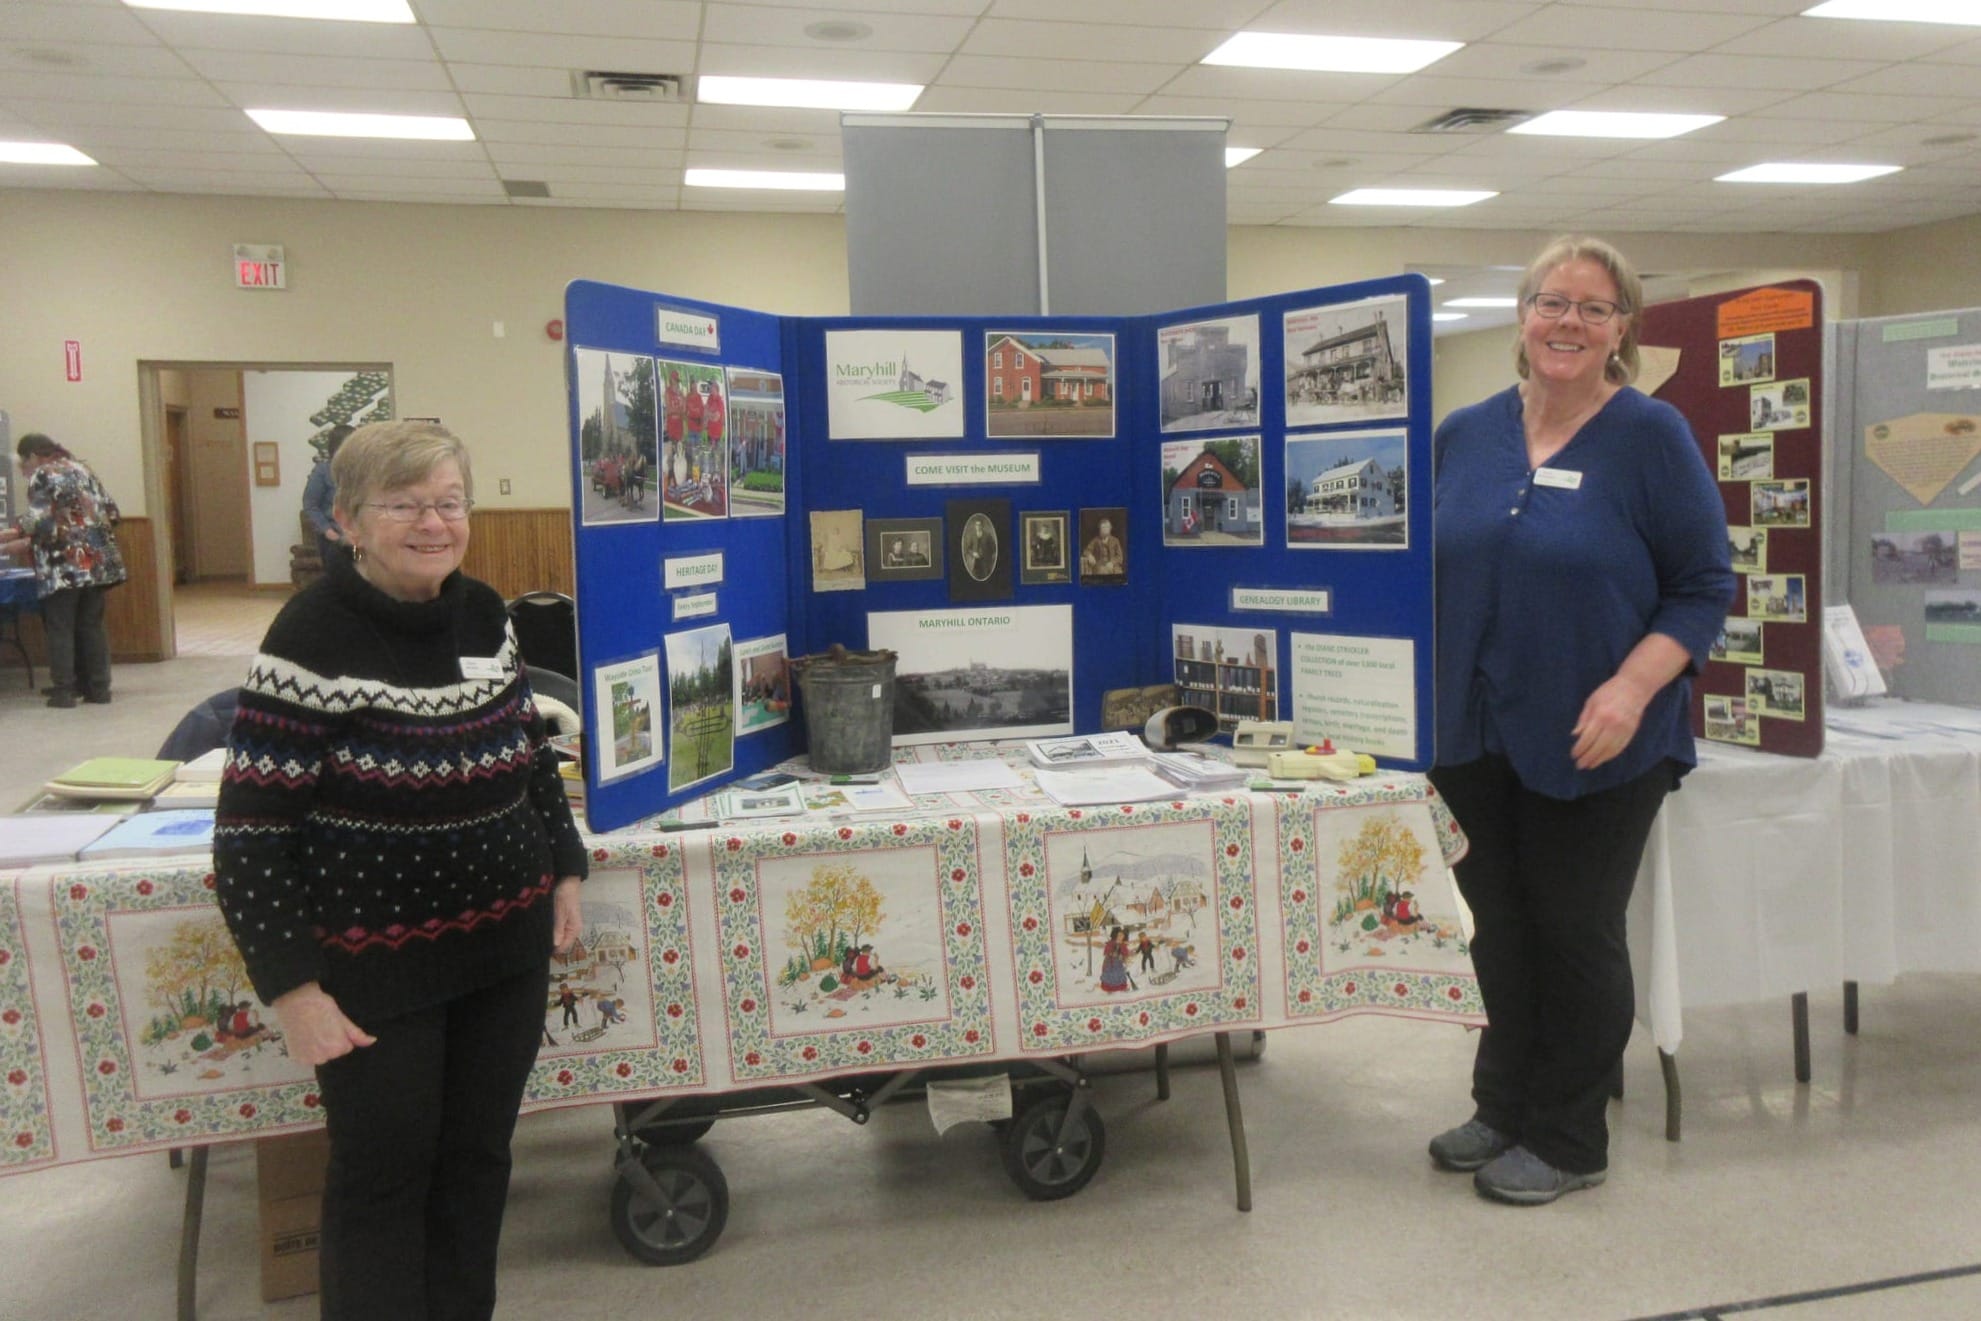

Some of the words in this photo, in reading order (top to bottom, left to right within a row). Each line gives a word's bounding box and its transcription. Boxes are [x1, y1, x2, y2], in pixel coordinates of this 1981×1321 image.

[240, 261, 279, 286] EXIT
[665, 321, 694, 336] CANADA
[694, 325, 706, 337] DAY
[836, 361, 896, 380] Maryhill
[914, 465, 943, 475] COME
[945, 464, 969, 474] VISIT
[970, 463, 985, 473] the
[987, 463, 1031, 473] MUSEUM
[676, 564, 706, 577] HERITAGE
[706, 563, 718, 575] DAY
[1239, 595, 1285, 605] GENEALOGY
[1287, 596, 1321, 606] LIBRARY
[919, 617, 966, 628] MARYHILL
[967, 616, 1010, 627] ONTARIO
